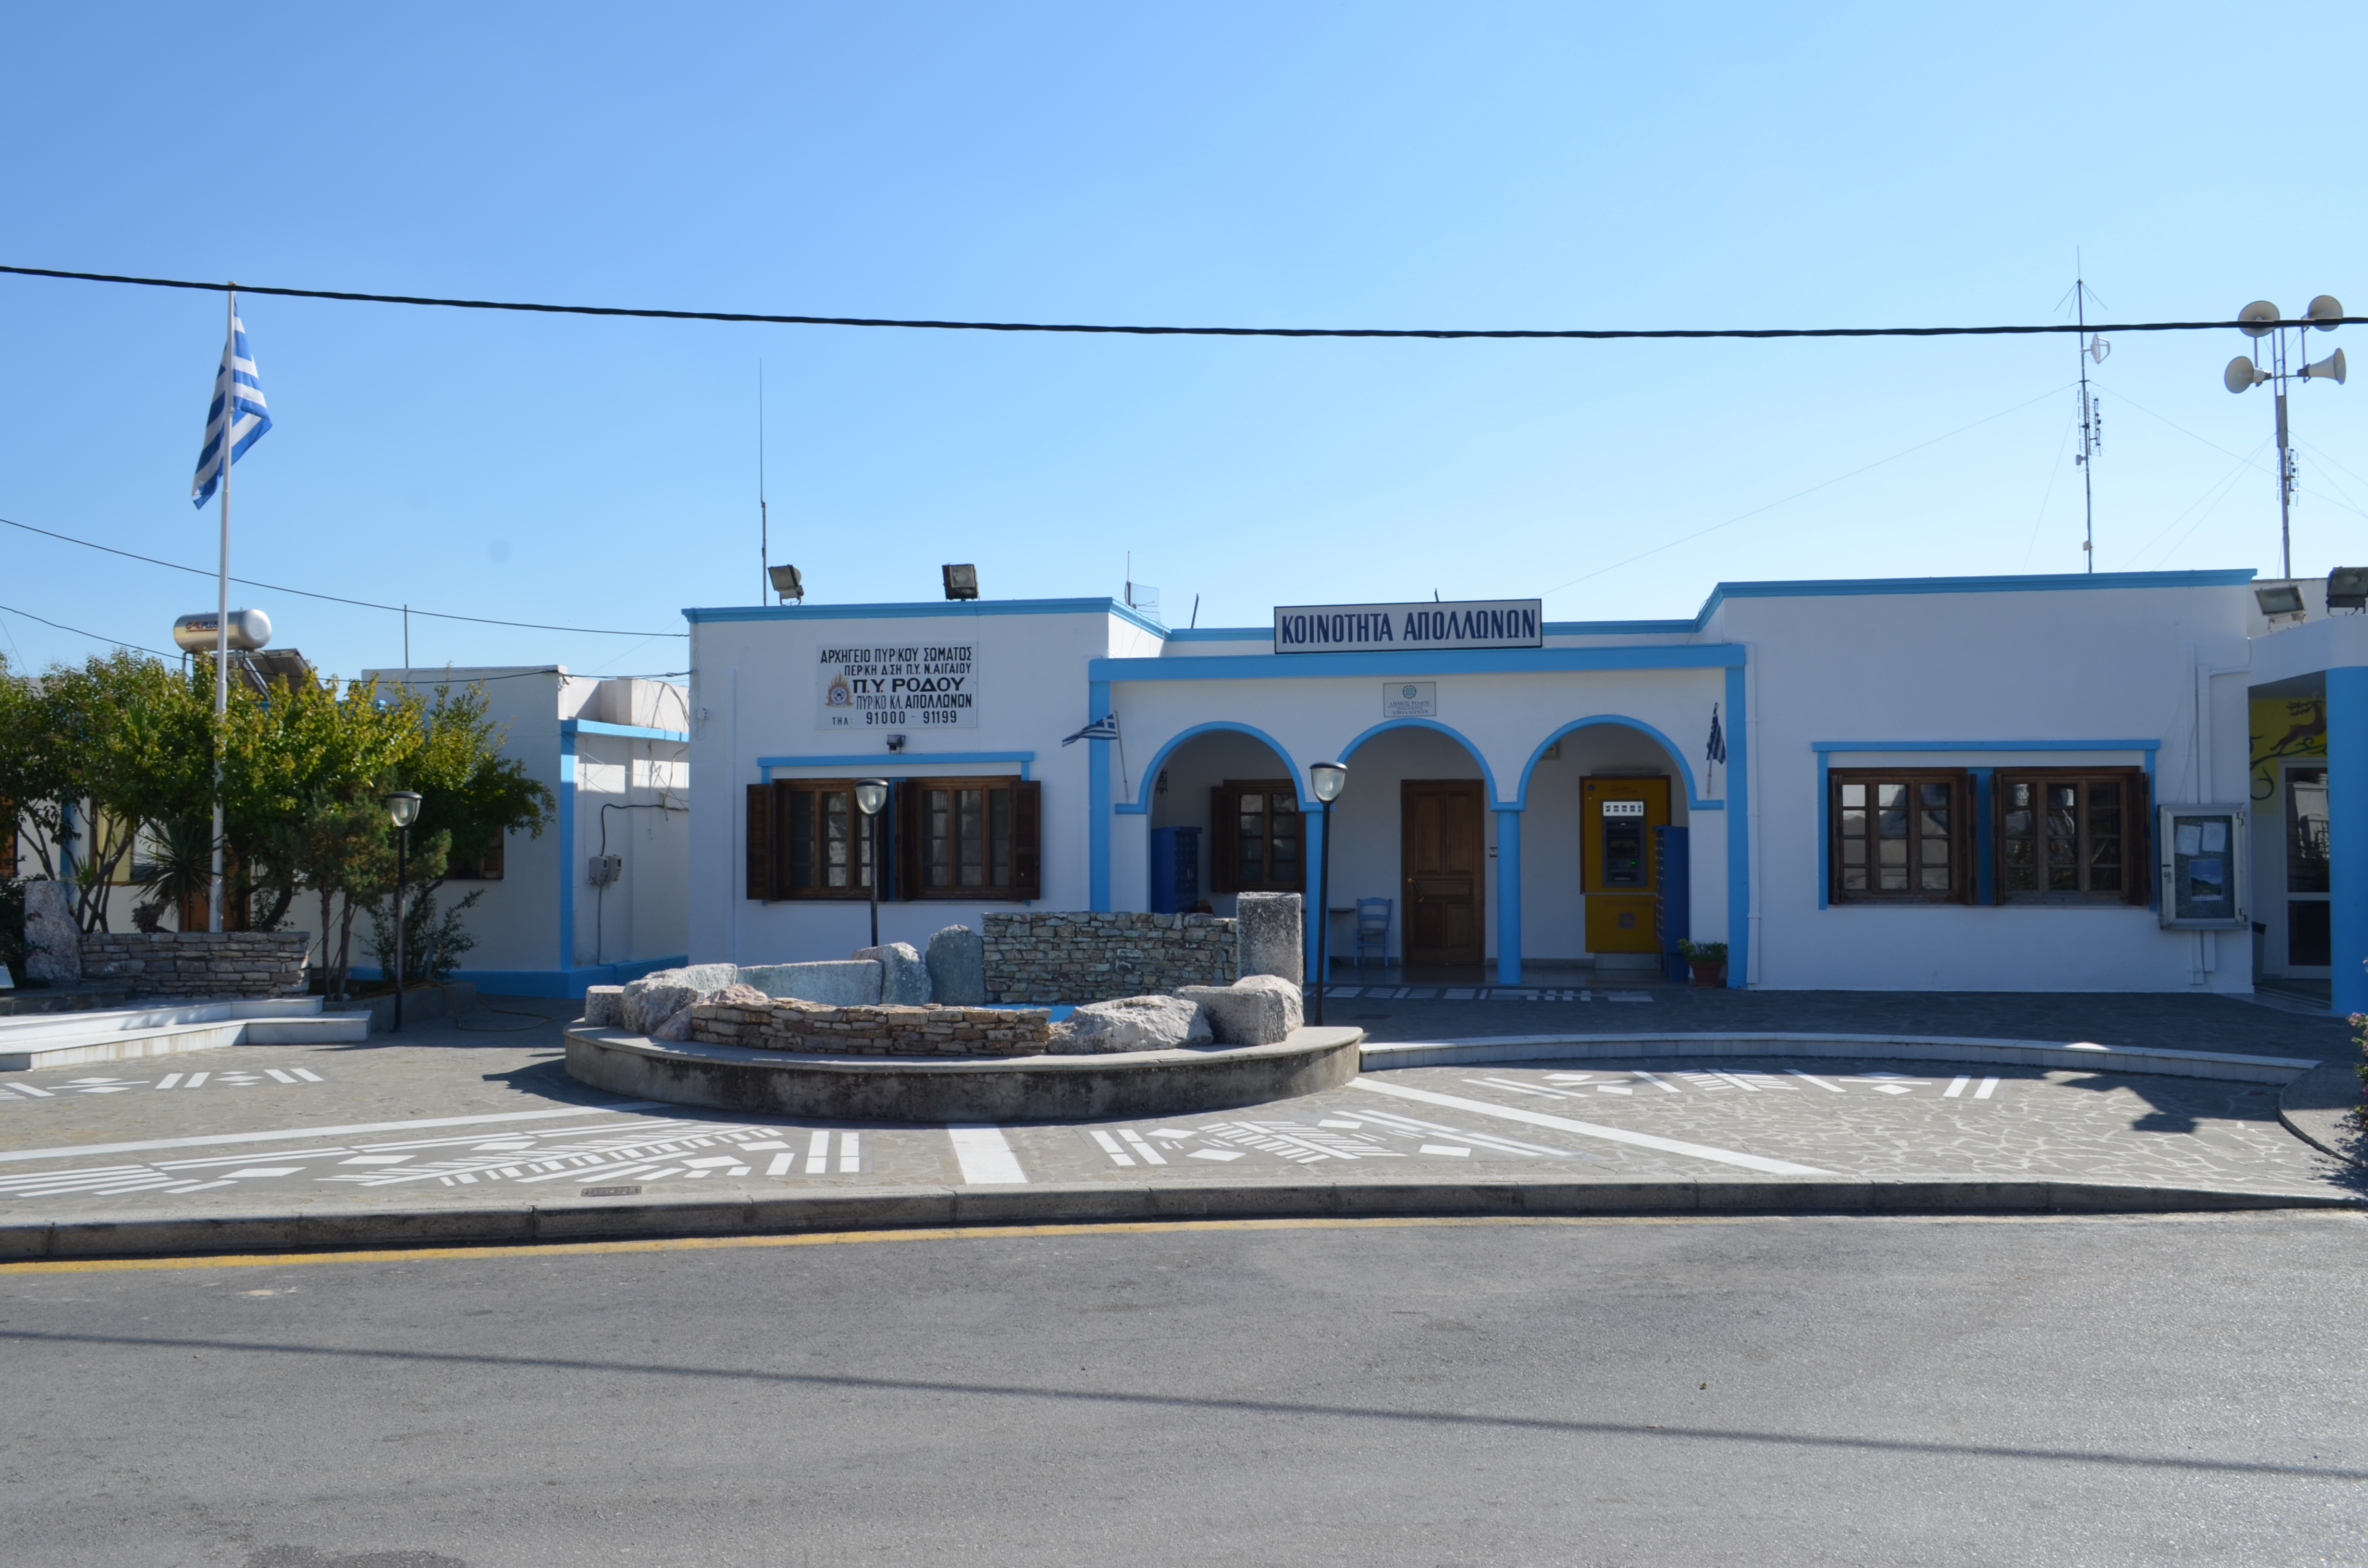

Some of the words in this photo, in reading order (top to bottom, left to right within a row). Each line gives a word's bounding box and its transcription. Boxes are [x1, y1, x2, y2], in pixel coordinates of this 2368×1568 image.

[1282, 612, 1394, 644] ΚΟΙΝΟΤΗΤΑ
[1403, 609, 1535, 641] ΑΠΟΛΛΩΝΩΝ
[820, 649, 871, 663] ΑΡΧΗΓΕΙΟ
[924, 647, 972, 662] ΣΩΜΑΤΟΣ
[892, 676, 965, 693] ΡΟΔΟΥ
[904, 693, 972, 709] ΑΠΟΛΛΩΝΩΝ
[866, 710, 906, 725] 91000
[923, 710, 957, 724] 91199
